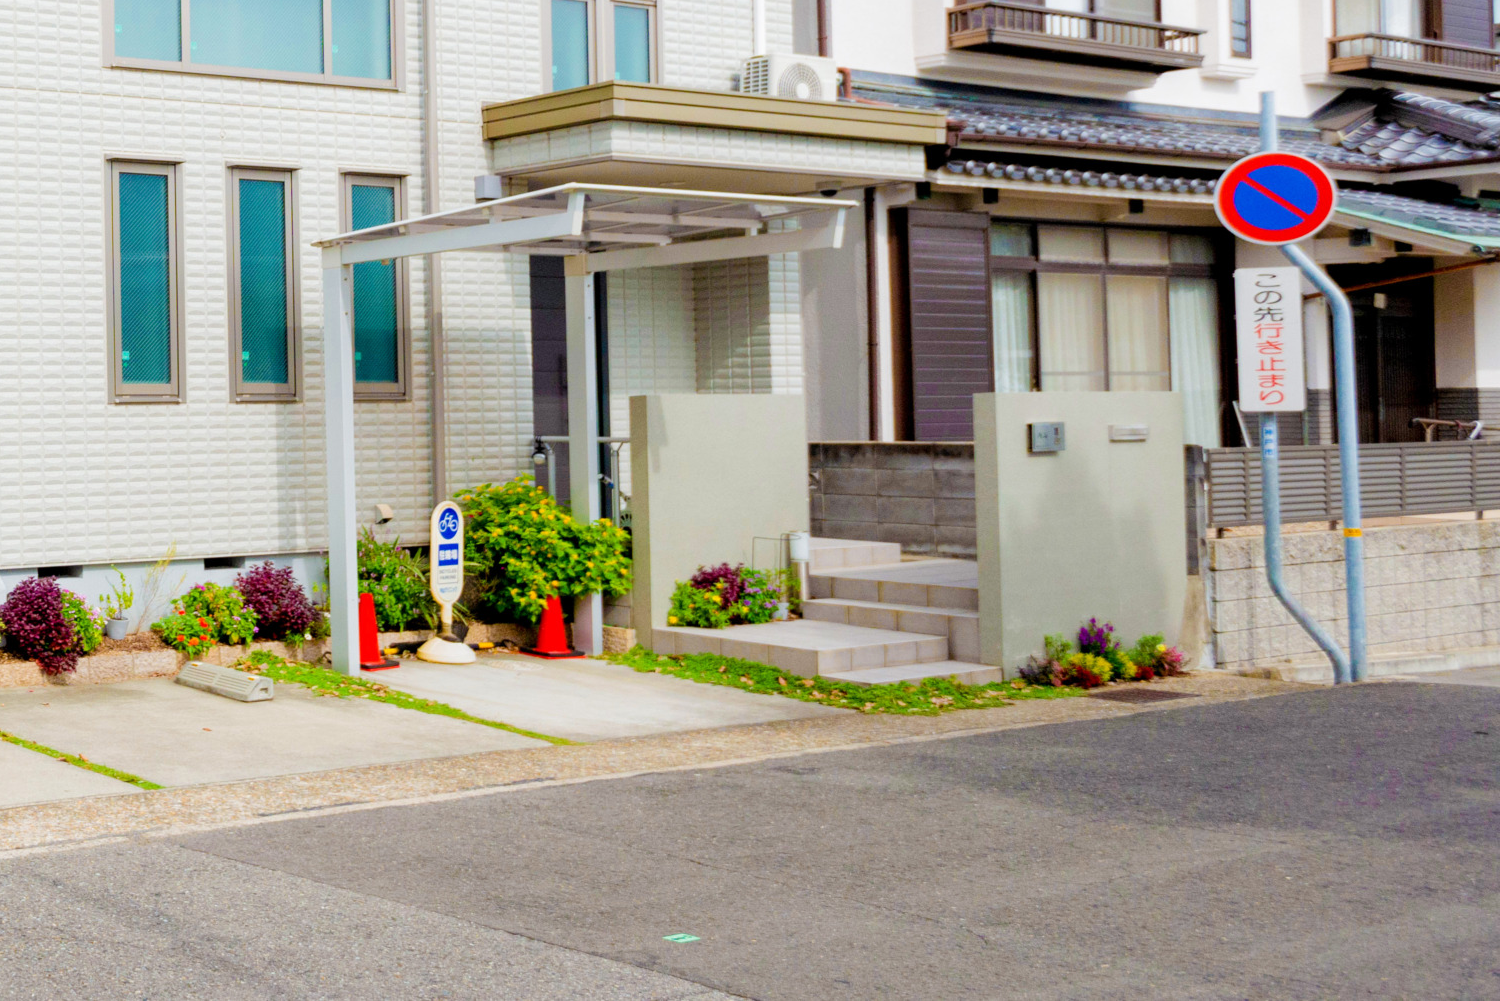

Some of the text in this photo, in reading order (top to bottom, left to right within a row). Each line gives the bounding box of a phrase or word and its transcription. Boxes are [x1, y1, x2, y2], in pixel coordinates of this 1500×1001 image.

[1254, 273, 1286, 405] この先行き止まり
